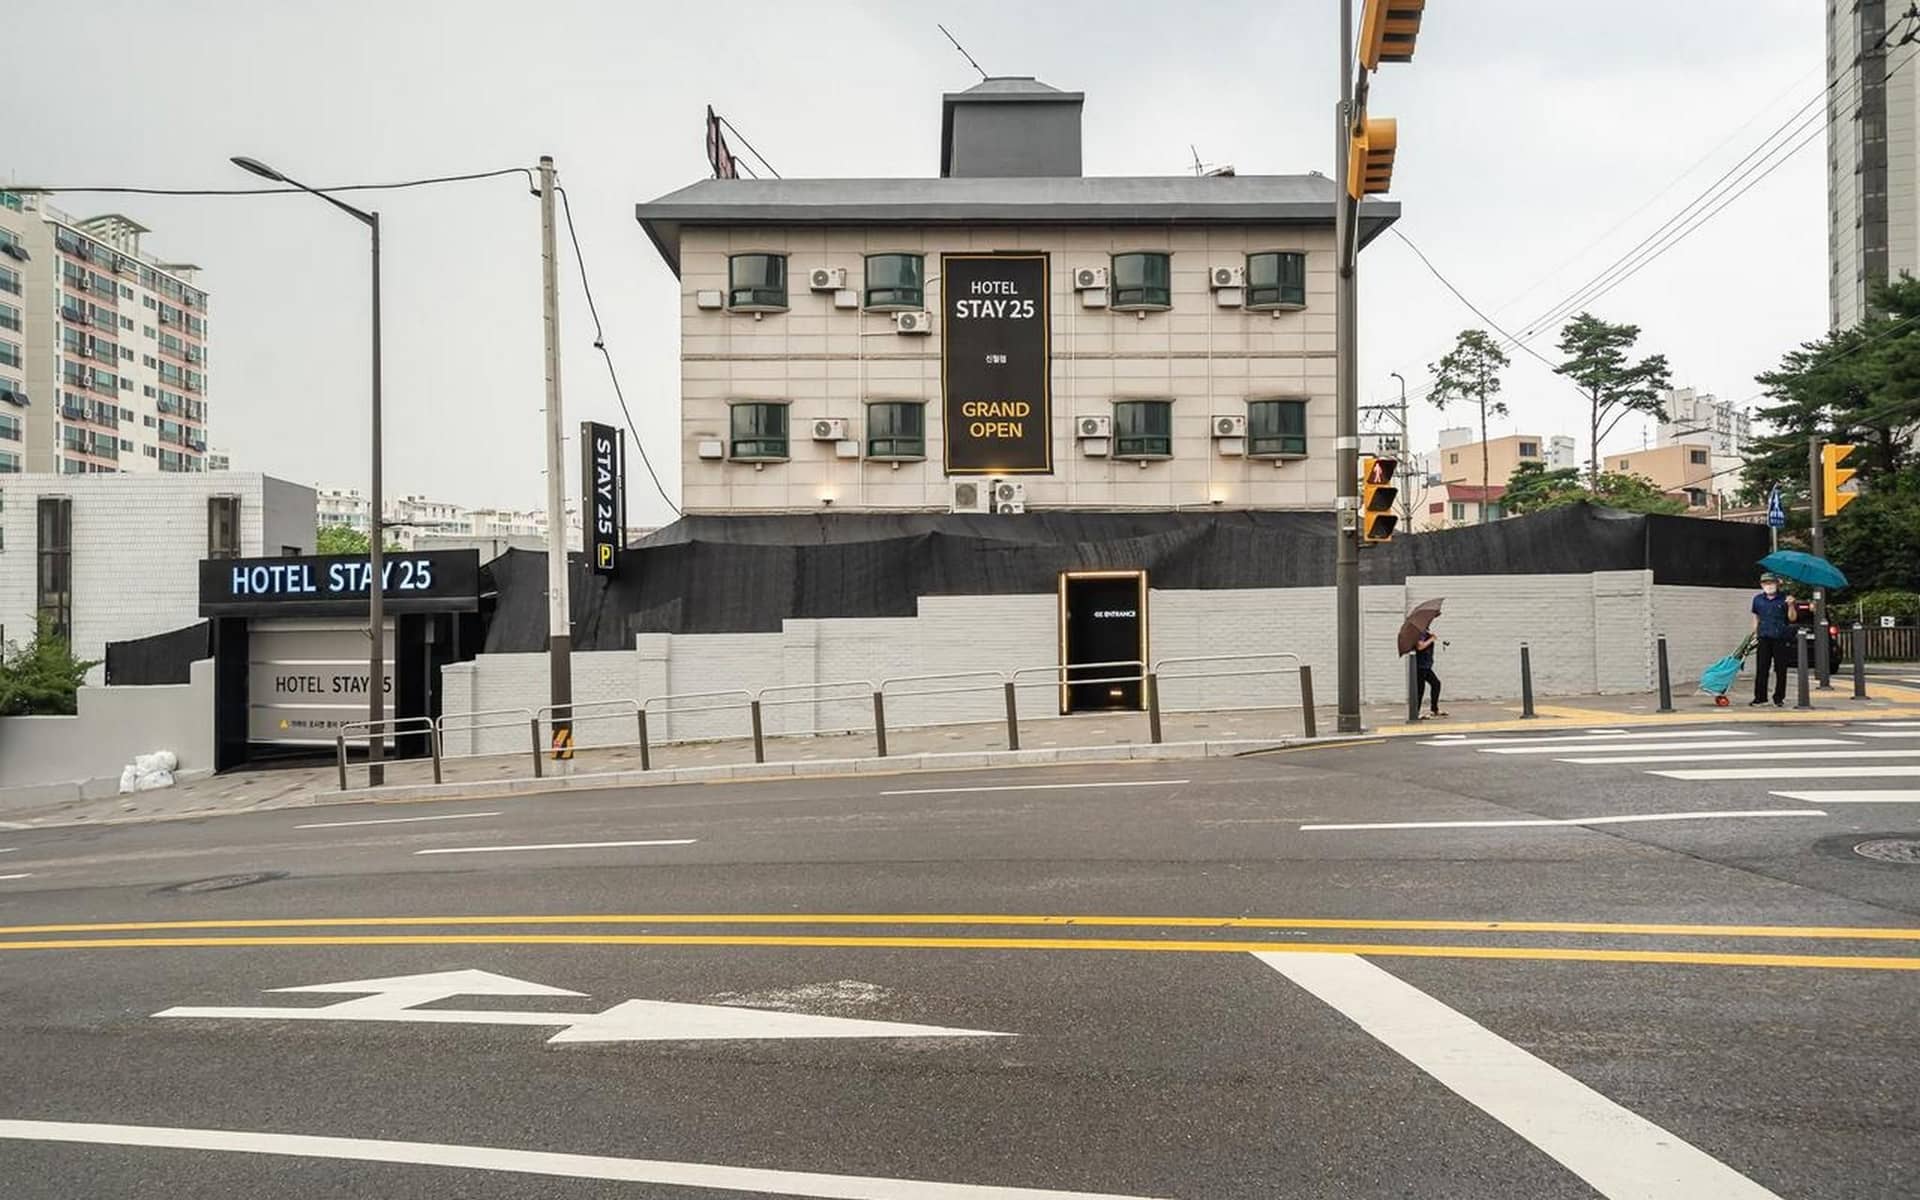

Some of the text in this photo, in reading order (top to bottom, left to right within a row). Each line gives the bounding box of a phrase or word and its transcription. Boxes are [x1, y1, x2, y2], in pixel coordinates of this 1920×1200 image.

[971, 281, 1018, 294] HOTEL
[956, 300, 1034, 318] STAY 25
[962, 401, 1030, 417] GRAND
[970, 422, 1022, 438] OPEN
[597, 437, 612, 534] STAY 25
[233, 560, 431, 594] HOTEL STAY 25
[276, 676, 325, 693] HOTEL
[332, 676, 369, 693] STAY
